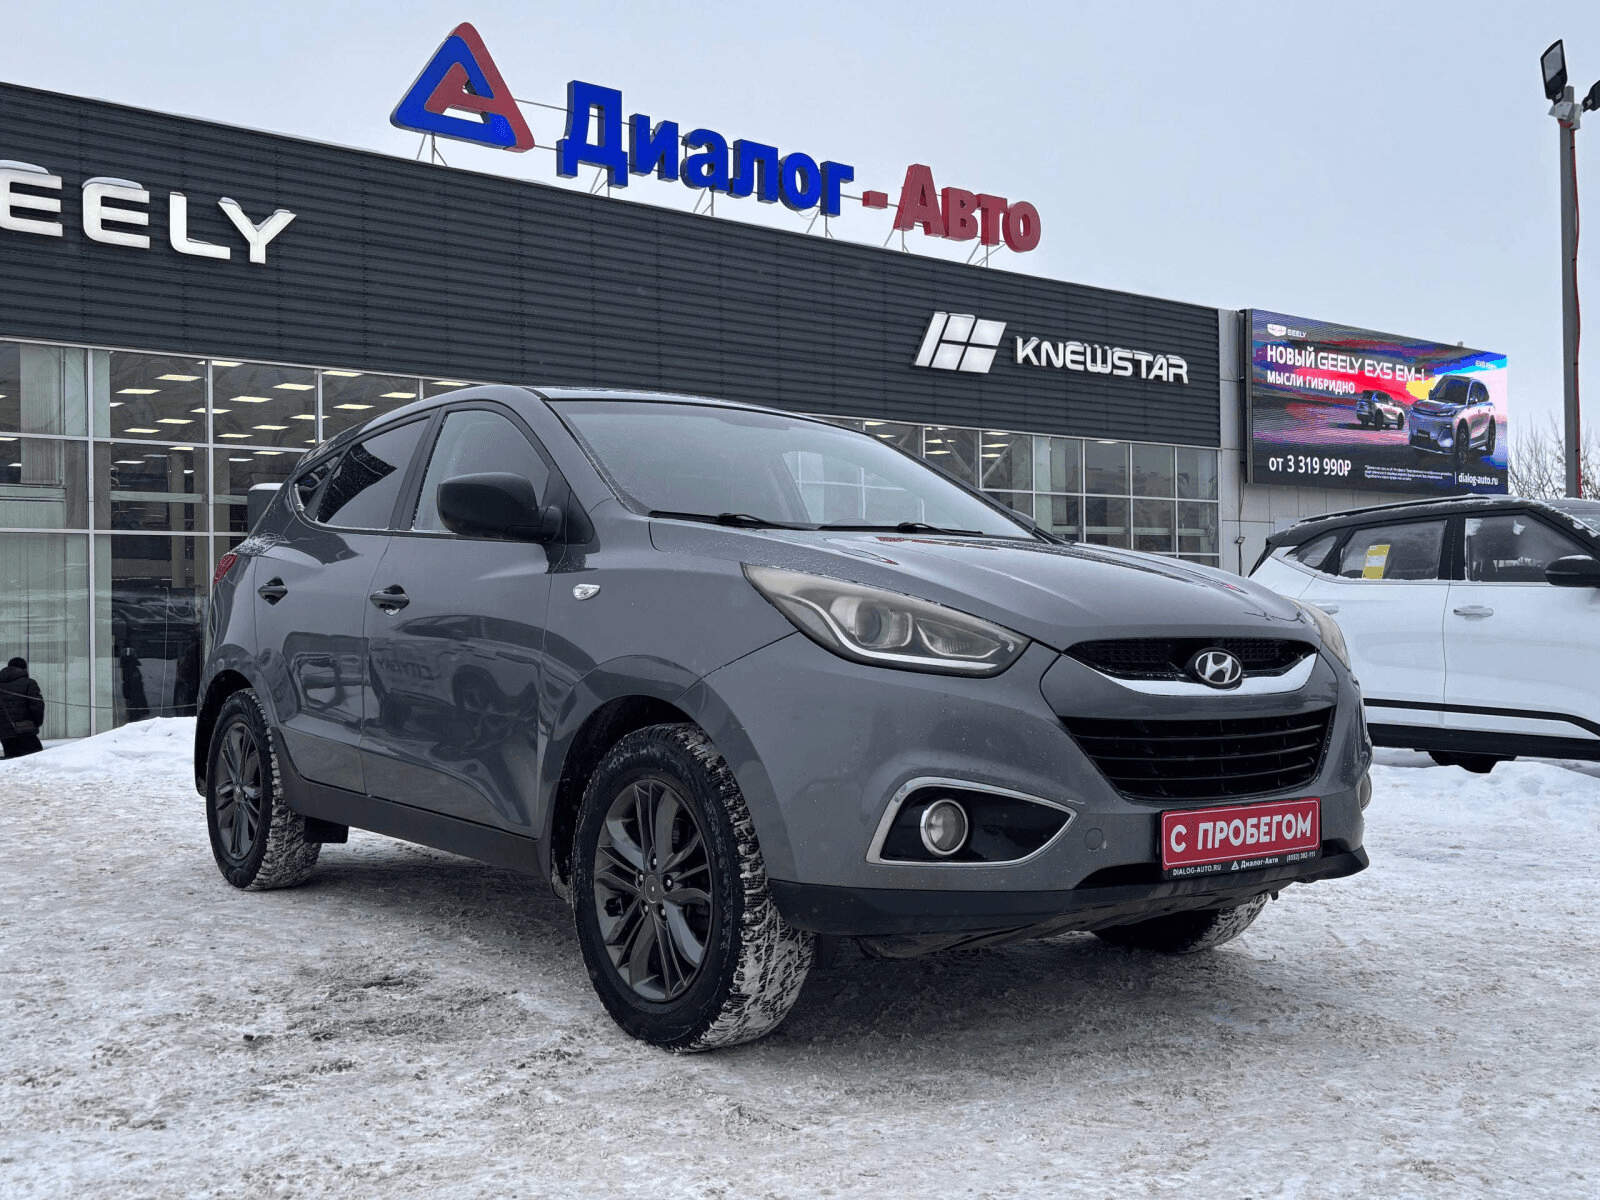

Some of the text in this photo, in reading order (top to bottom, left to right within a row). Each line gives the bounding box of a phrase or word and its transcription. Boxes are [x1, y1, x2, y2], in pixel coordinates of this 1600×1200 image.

[556, 79, 1041, 253] Диалог-Авто
[1015, 335, 1189, 384] KNEWSTAR
[1266, 344, 1315, 368] НОВЫЙ
[1317, 352, 1362, 374] GEELY
[1364, 359, 1392, 380] EX5
[1266, 370, 1356, 395] МЫСЛИ ГИБРИДНО
[1286, 454, 1295, 473] 3
[1297, 455, 1320, 474] 319
[1458, 472, 1499, 486] dialog-auto.ru
[1170, 810, 1313, 853] С ПРОБЕГОМ
[1172, 864, 1222, 876] DIALOG-AUTO.RU
[1240, 857, 1279, 869] Диалог-Авто
